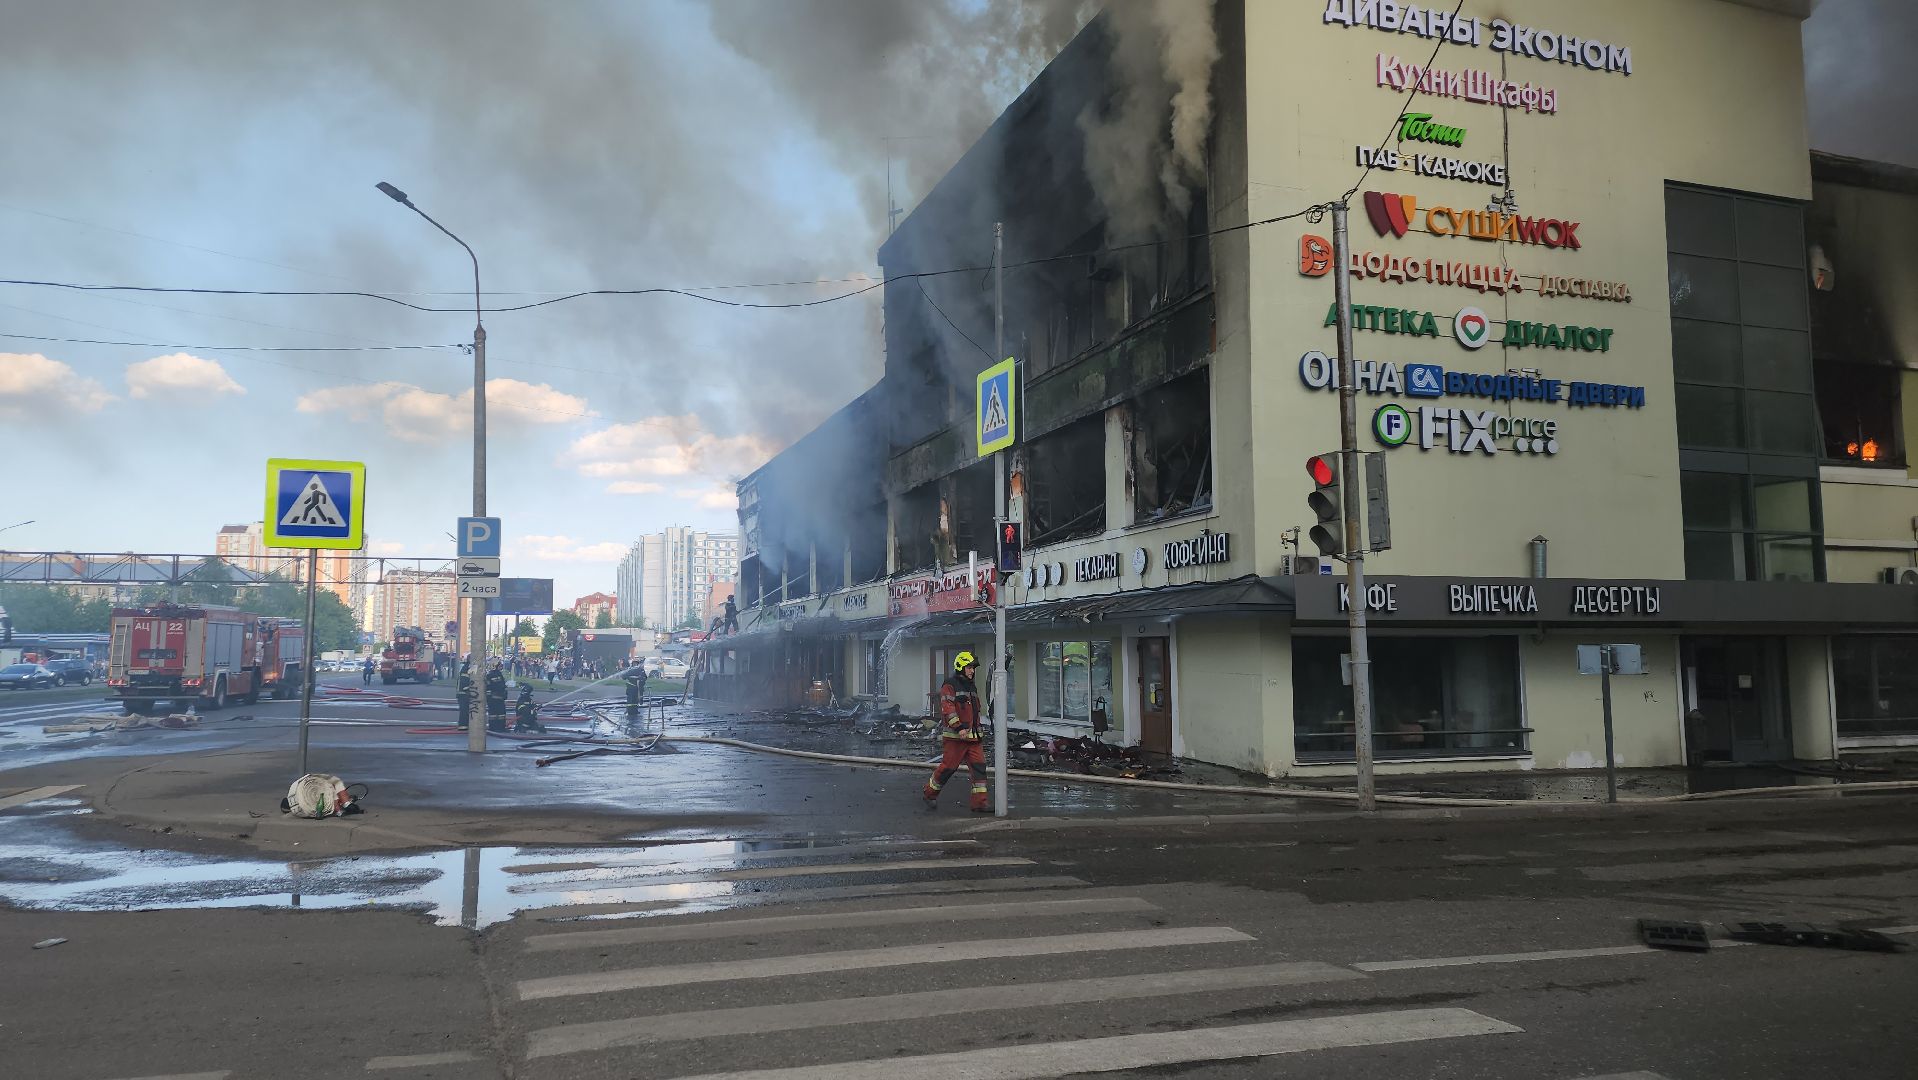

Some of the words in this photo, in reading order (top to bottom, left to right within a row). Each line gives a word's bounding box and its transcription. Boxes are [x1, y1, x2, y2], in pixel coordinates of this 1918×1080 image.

[1323, 0, 1480, 46] ДИВАНЫ
[1490, 18, 1632, 75] ЭКОНОМ
[1398, 112, 1467, 147] Тости
[1356, 145, 1398, 171] ПАБ
[1415, 154, 1505, 186] КАРАОКЕ
[1539, 275, 1633, 303] ДОСТАВКА
[1503, 320, 1613, 353] ДИАЛОГ
[1446, 371, 1562, 402] ВХОДНЫЕ
[1568, 381, 1645, 407] ДВЕРИ
[1074, 552, 1120, 583] ПЕКАРНЯ
[1163, 529, 1230, 570] КОФЕЙНЯ
[462, 582, 470, 592] 2
[1338, 583, 1398, 611] КФЕ
[1449, 585, 1538, 613] ВЫПЕЧКА
[1574, 586, 1660, 613] ДЕСЕРТЫ
[134, 622, 150, 632] АЦ
[169, 622, 183, 631] 22
